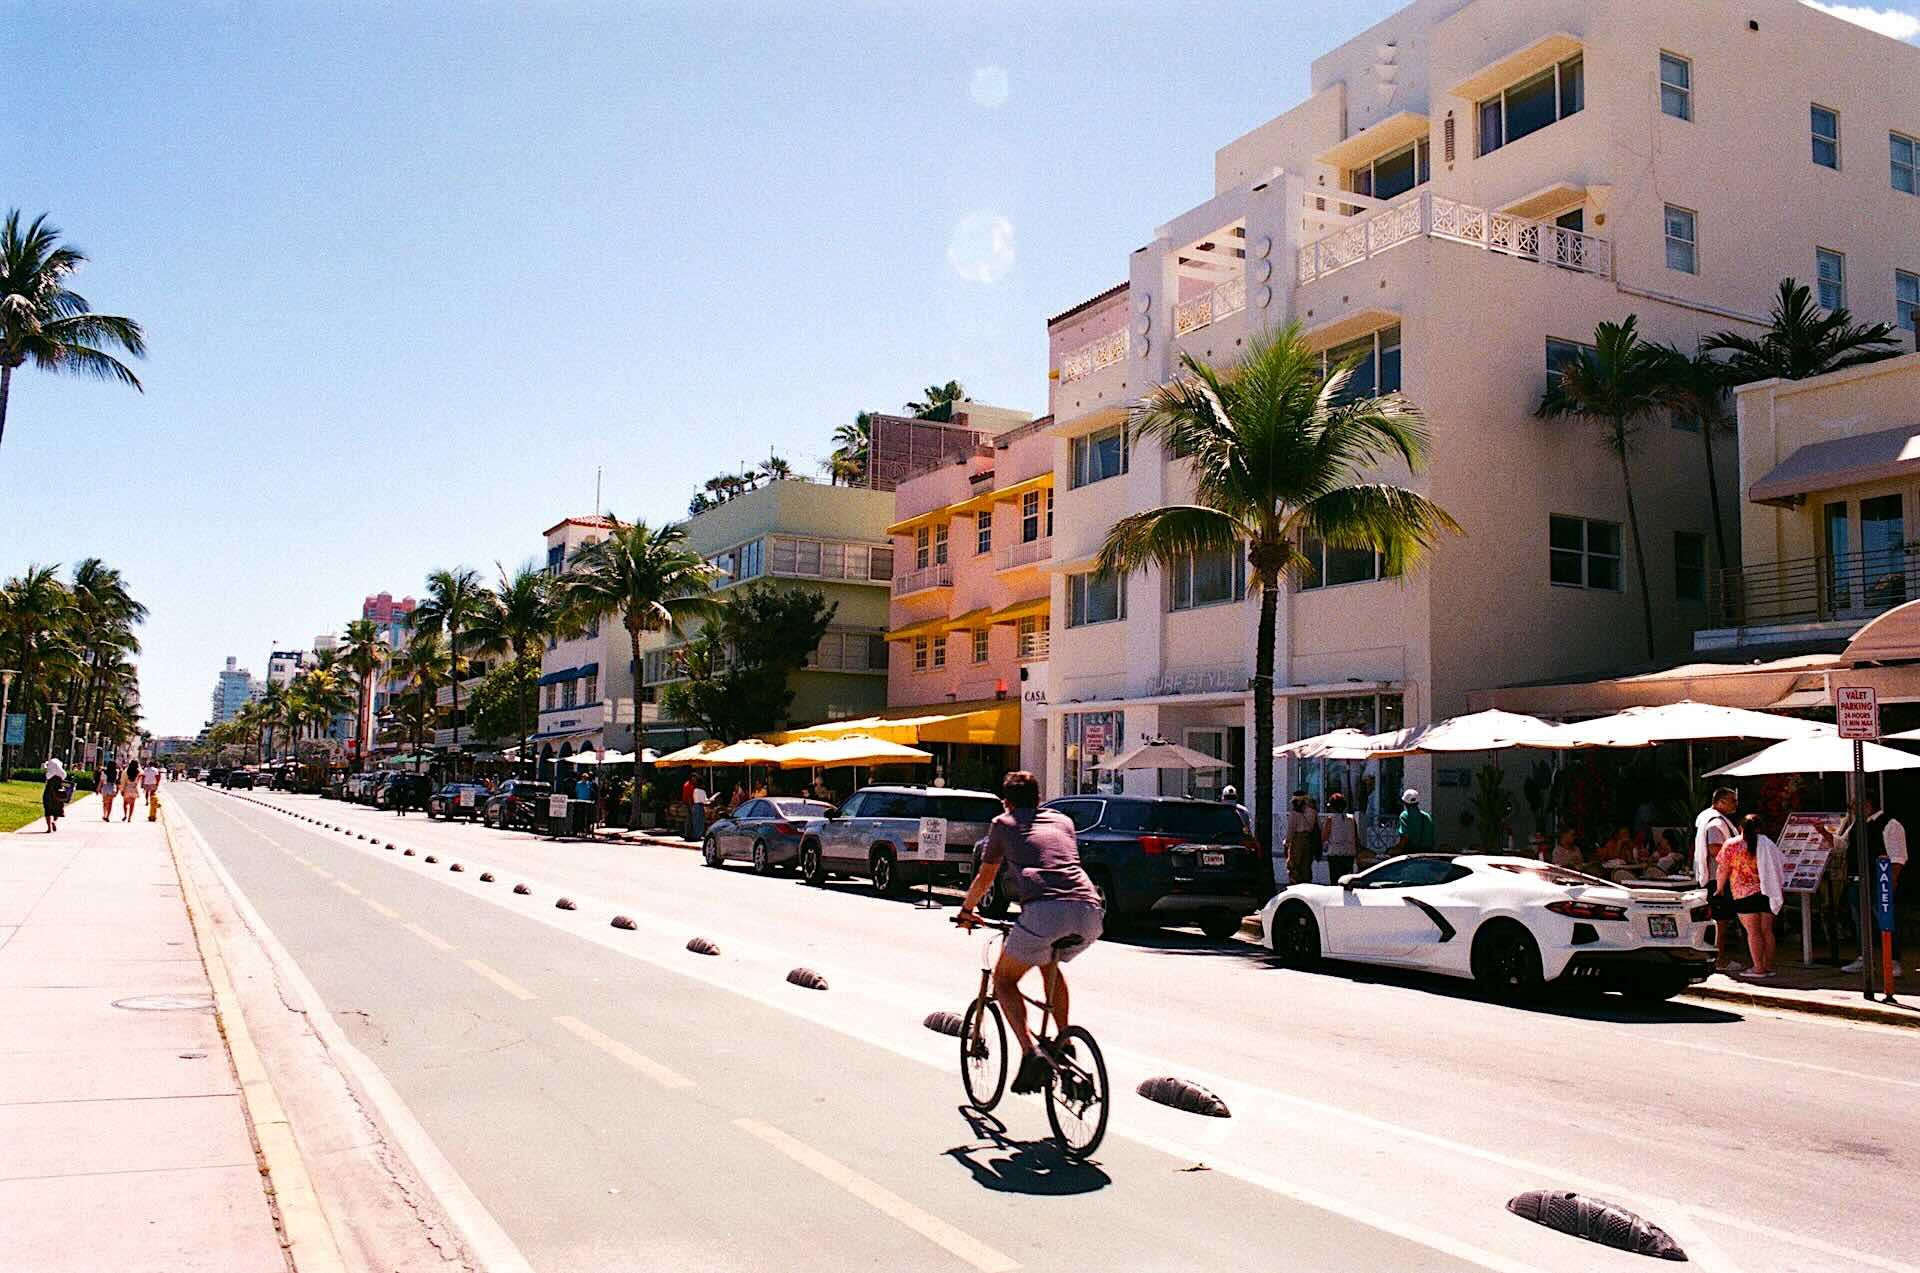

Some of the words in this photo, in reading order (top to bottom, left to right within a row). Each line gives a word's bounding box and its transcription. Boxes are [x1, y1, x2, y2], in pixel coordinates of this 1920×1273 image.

[1024, 690, 1046, 701] CASA
[1845, 690, 1867, 700] VALET
[1840, 702, 1873, 711] PARKING
[1879, 863, 1889, 912] VALET
